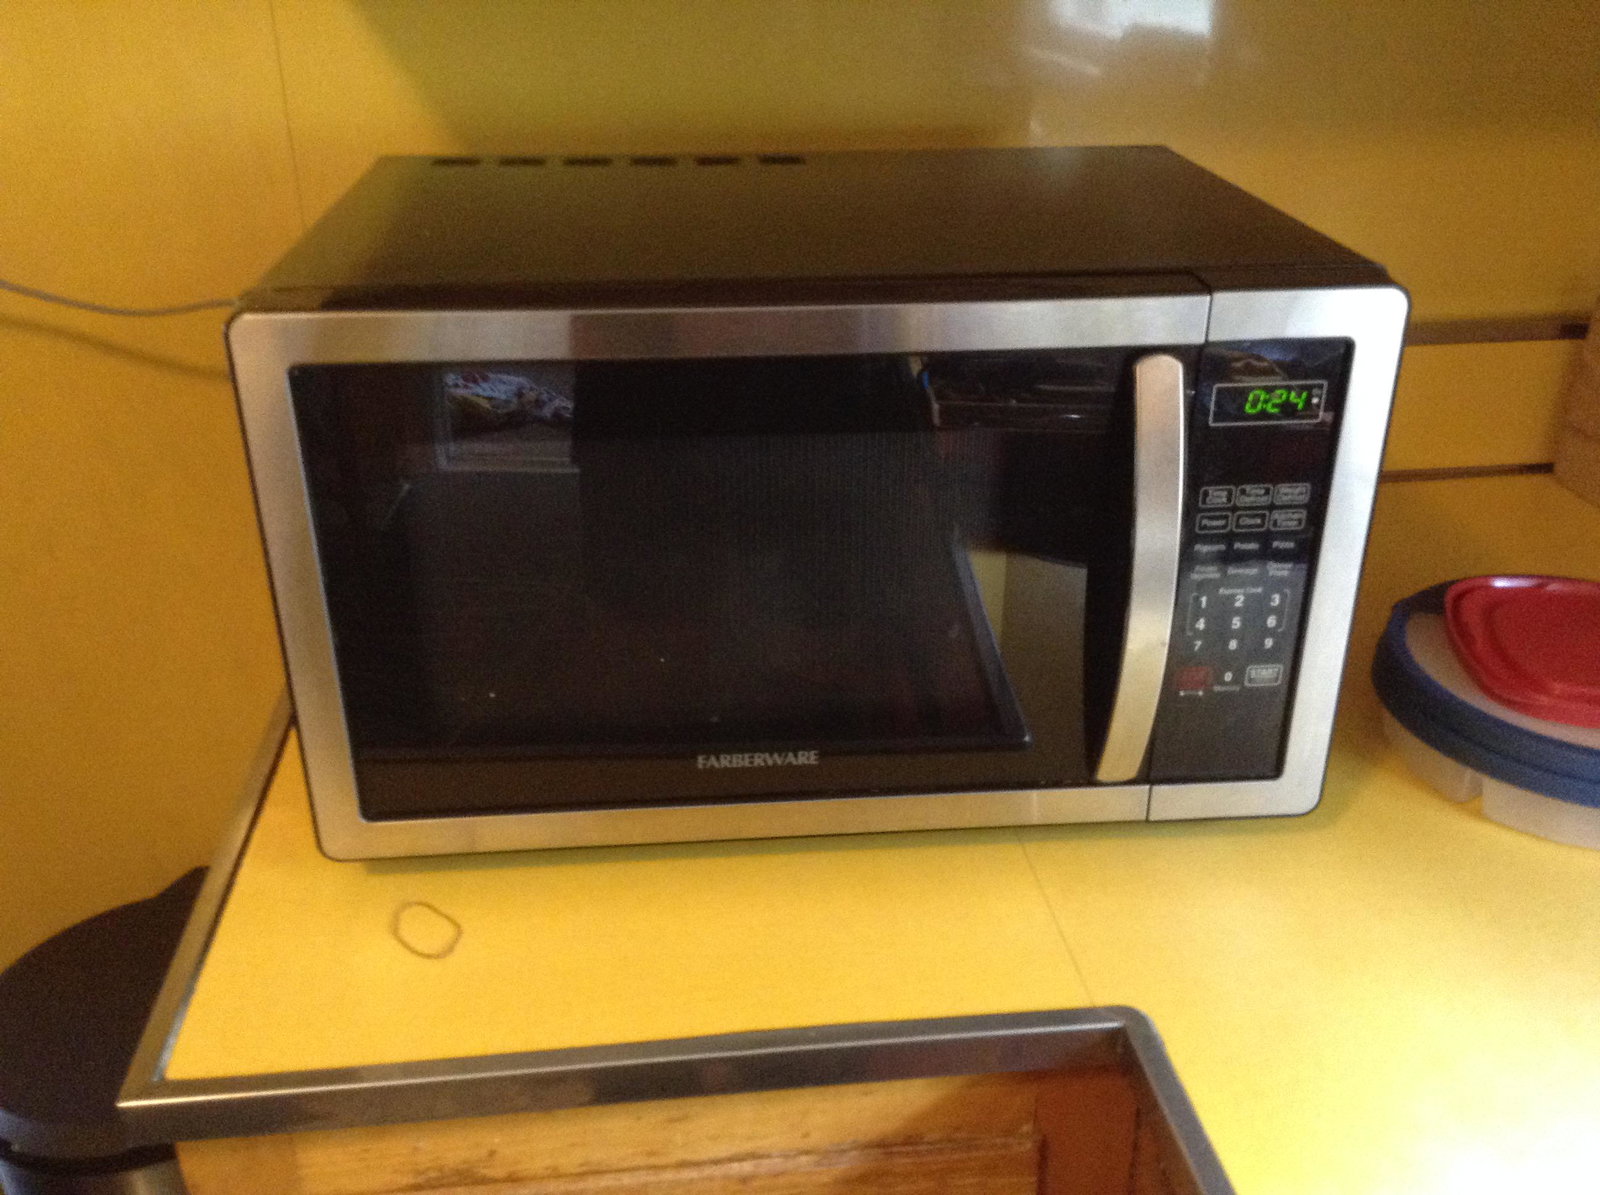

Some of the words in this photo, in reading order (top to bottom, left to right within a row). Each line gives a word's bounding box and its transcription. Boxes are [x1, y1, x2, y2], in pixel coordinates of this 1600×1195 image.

[1201, 595, 1208, 608] 1
[1234, 594, 1245, 607] 2
[1270, 593, 1280, 607] 3
[1195, 617, 1206, 630] 4
[1231, 616, 1242, 629] 5
[1266, 614, 1277, 628] 6
[1194, 640, 1202, 651] 7
[1228, 638, 1238, 650] 8
[1264, 637, 1274, 649] 9
[697, 750, 820, 769] FARBERWARE
